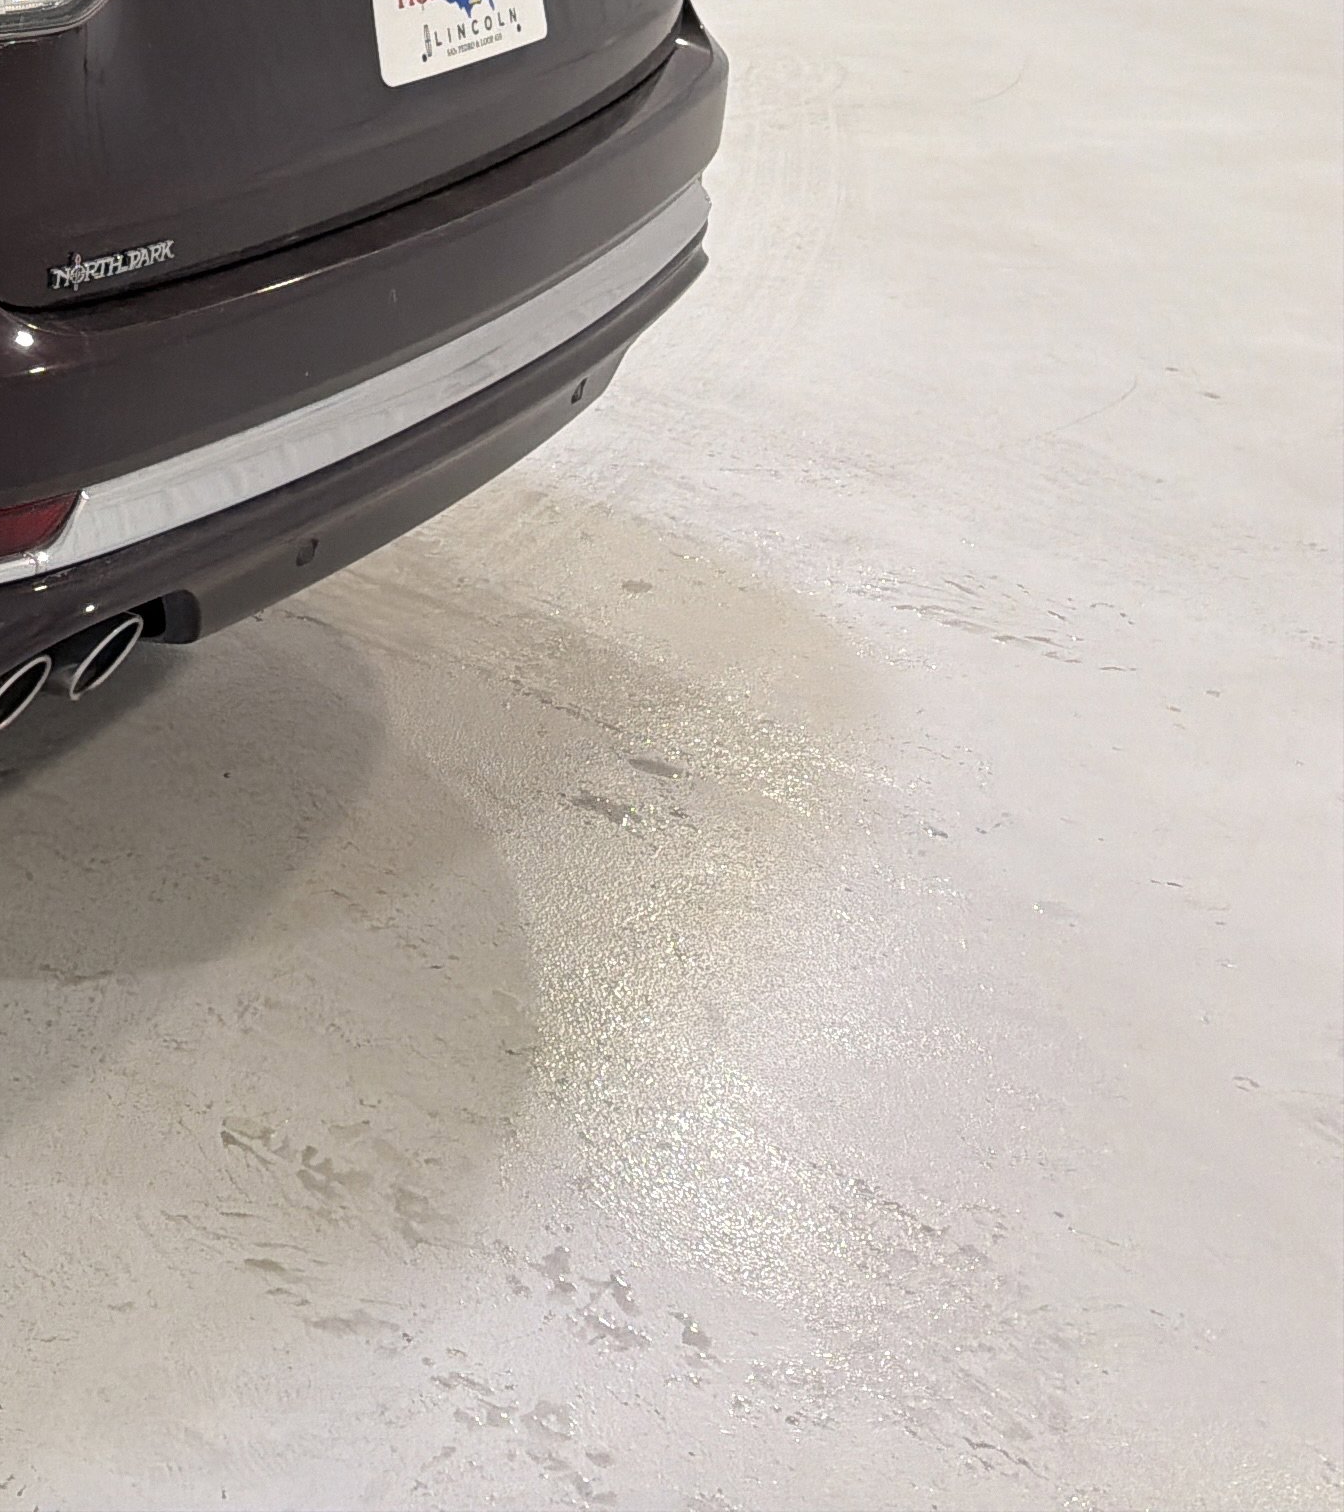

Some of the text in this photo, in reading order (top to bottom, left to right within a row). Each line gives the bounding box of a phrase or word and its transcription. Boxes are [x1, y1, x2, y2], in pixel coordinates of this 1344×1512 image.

[434, 8, 518, 47] LINCOLN
[50, 240, 175, 290] NORTH PARK
